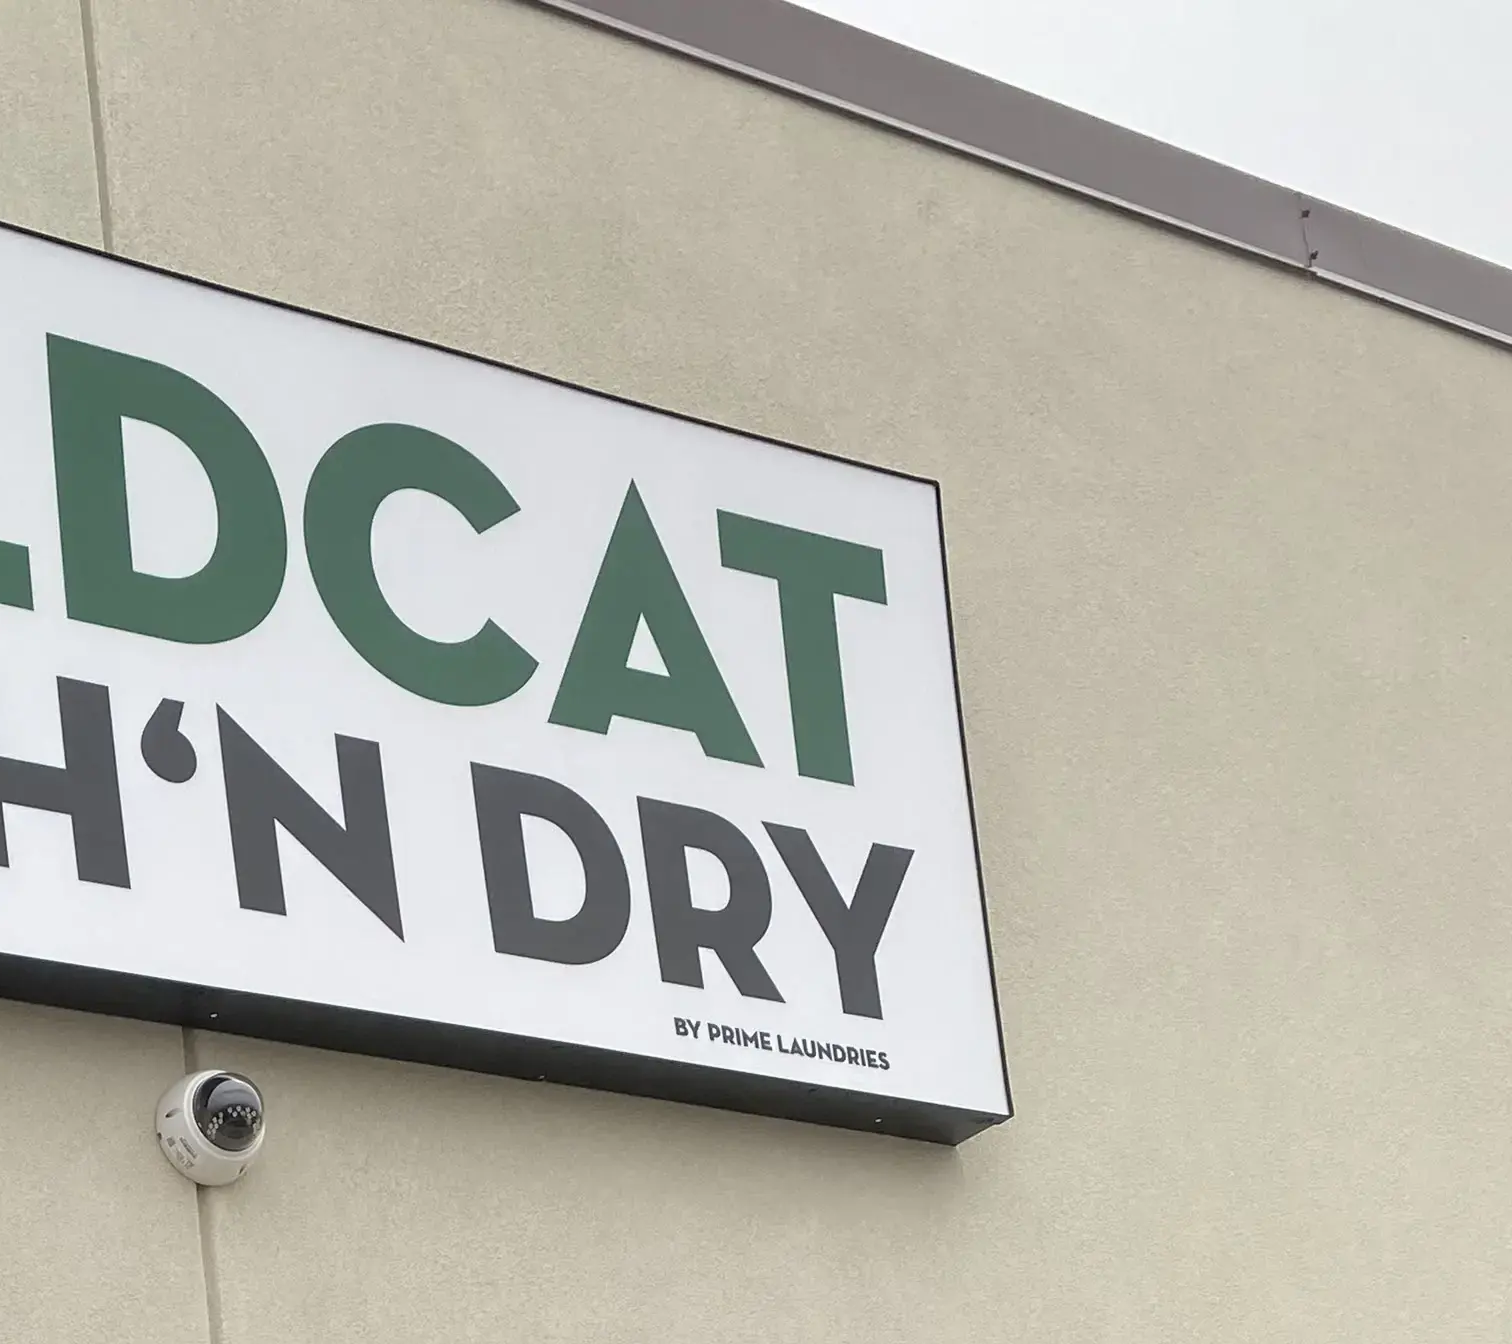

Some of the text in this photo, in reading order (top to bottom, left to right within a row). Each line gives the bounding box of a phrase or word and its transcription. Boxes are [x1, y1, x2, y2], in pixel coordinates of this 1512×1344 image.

[470, 761, 914, 1020] DRY
[674, 1017, 890, 1070] BY PRIME LAUNDRIES
